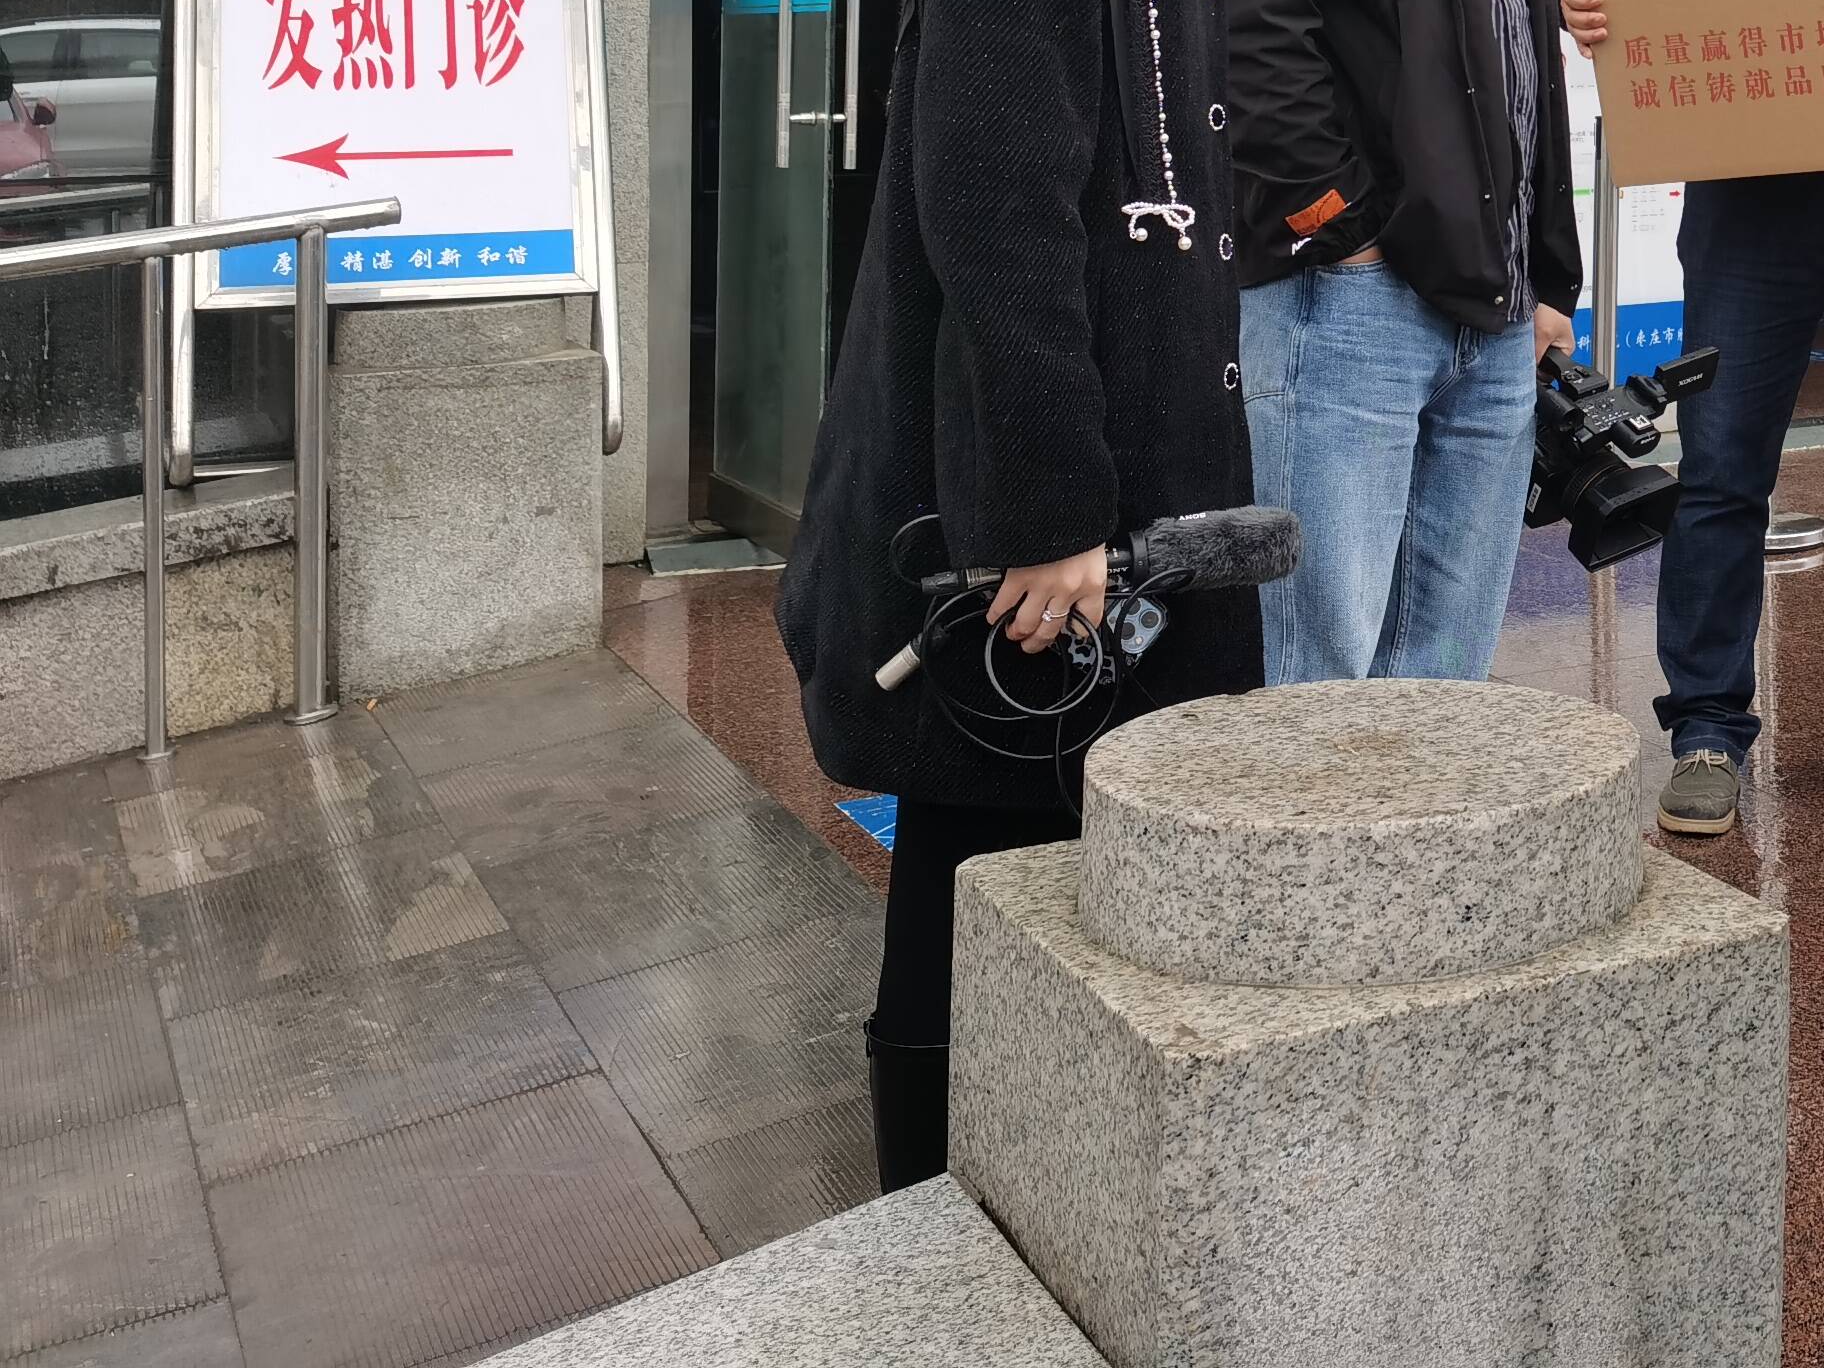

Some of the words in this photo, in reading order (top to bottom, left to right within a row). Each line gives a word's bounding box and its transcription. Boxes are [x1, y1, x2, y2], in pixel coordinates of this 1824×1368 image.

[340, 249, 394, 272] 精湛
[408, 246, 461, 268] 创新
[478, 245, 529, 266] 和谐
[1178, 511, 1207, 521] SONY
